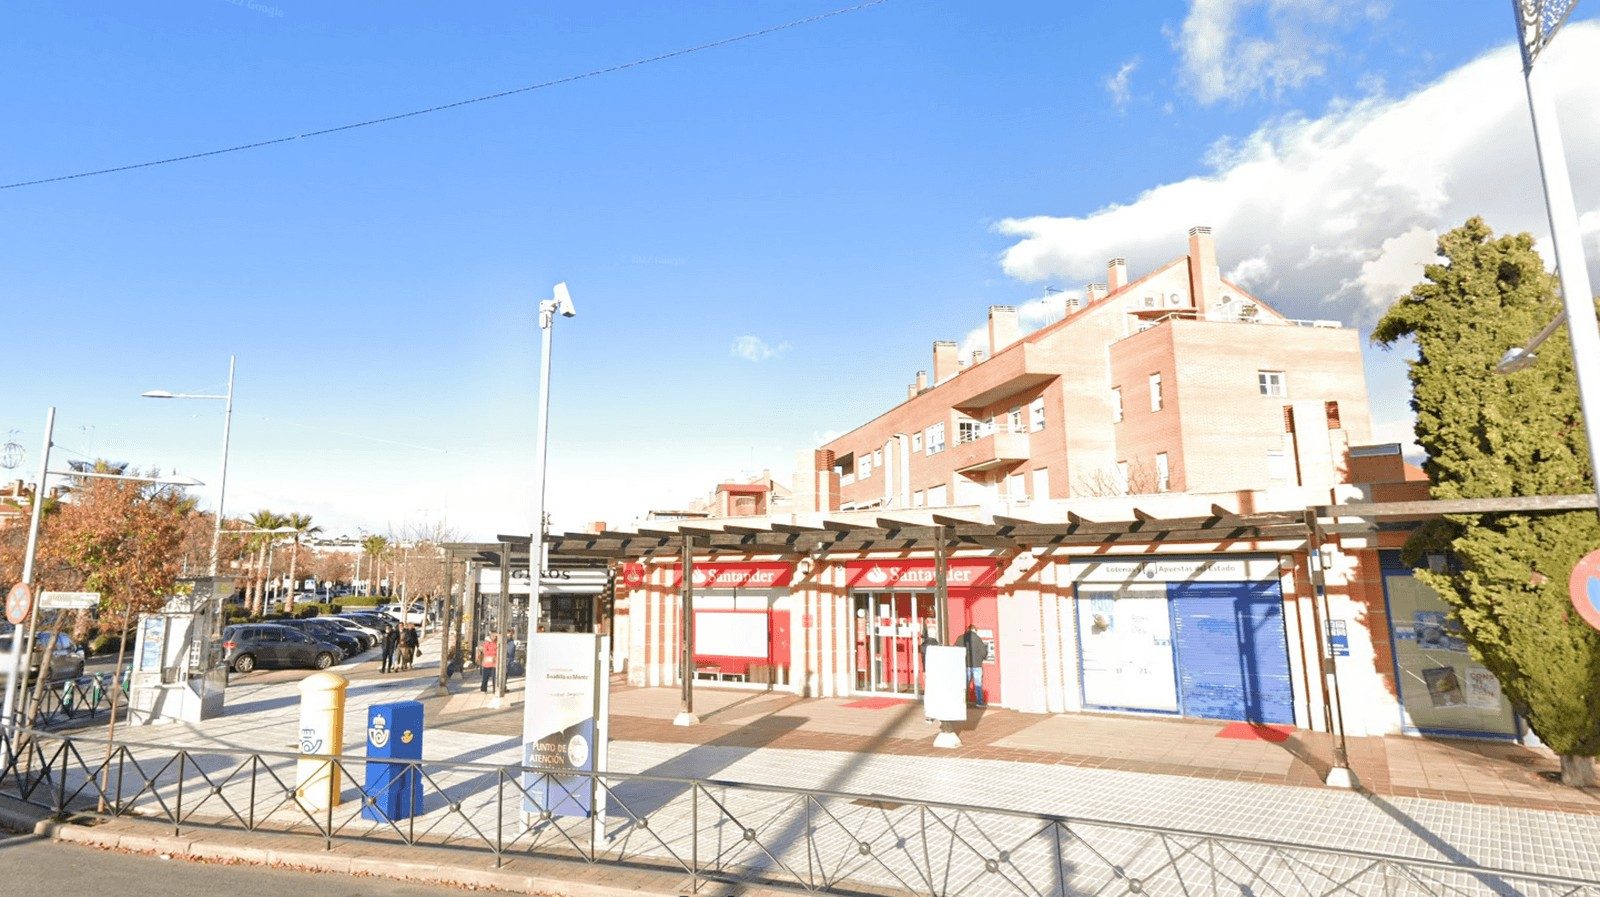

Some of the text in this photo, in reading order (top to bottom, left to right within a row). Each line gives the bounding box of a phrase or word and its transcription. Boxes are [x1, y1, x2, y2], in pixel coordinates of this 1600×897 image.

[708, 567, 774, 583] Santander
[890, 564, 971, 582] Santader
[533, 742, 567, 753] PUNTO DE
[529, 753, 565, 764] ATENCIÓN
